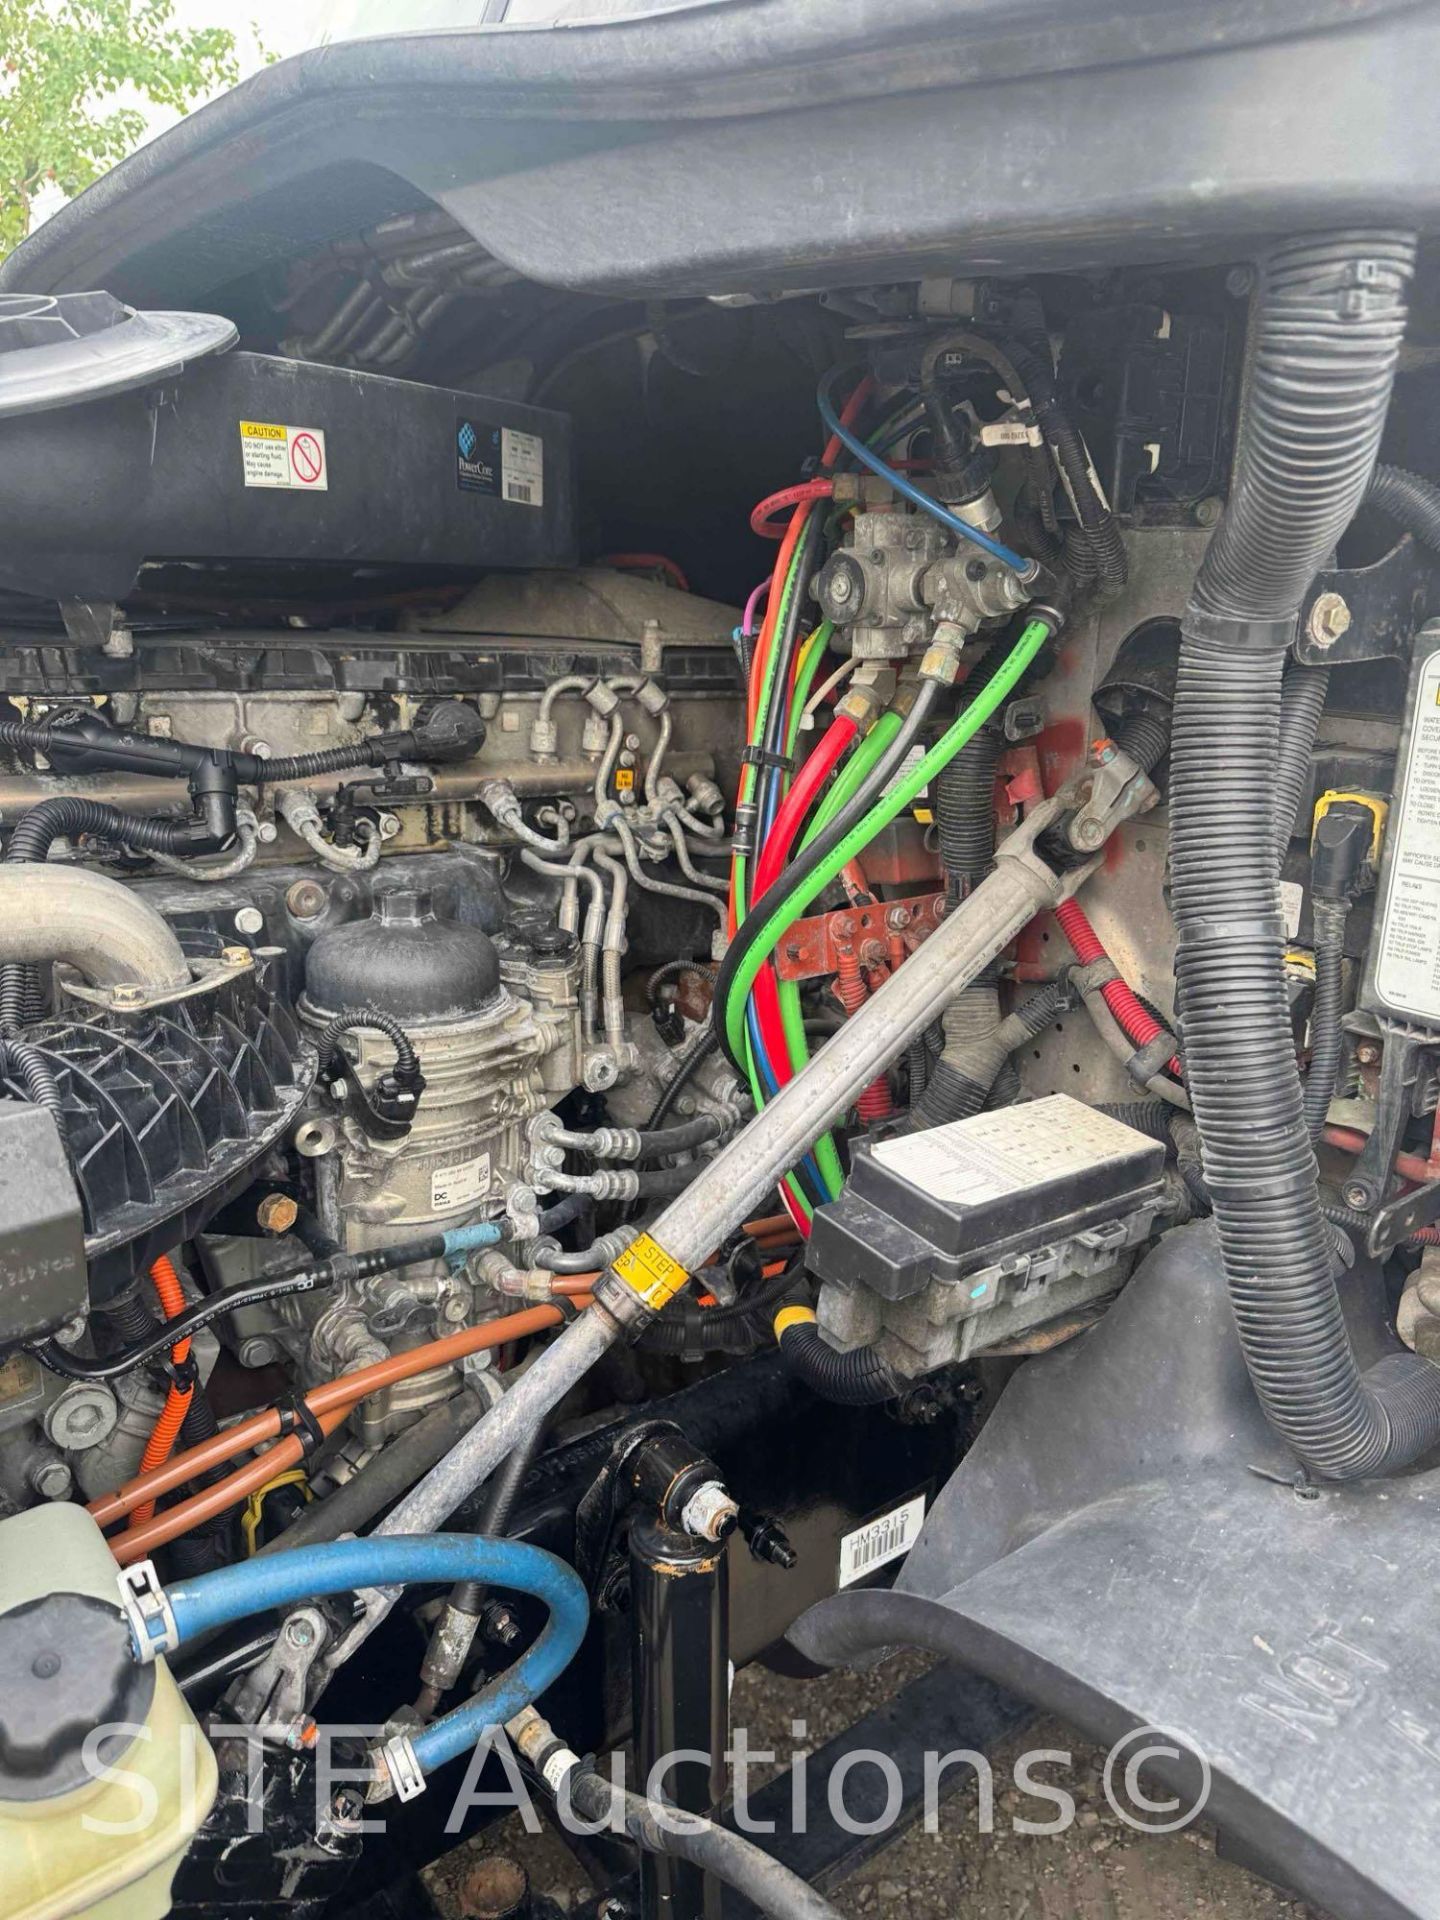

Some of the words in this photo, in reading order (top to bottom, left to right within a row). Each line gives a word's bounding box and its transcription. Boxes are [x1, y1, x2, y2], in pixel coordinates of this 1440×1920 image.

[247, 426, 281, 438] CAUTION
[644, 1246, 675, 1274] STEP
[850, 1508, 910, 1550] HM3315
